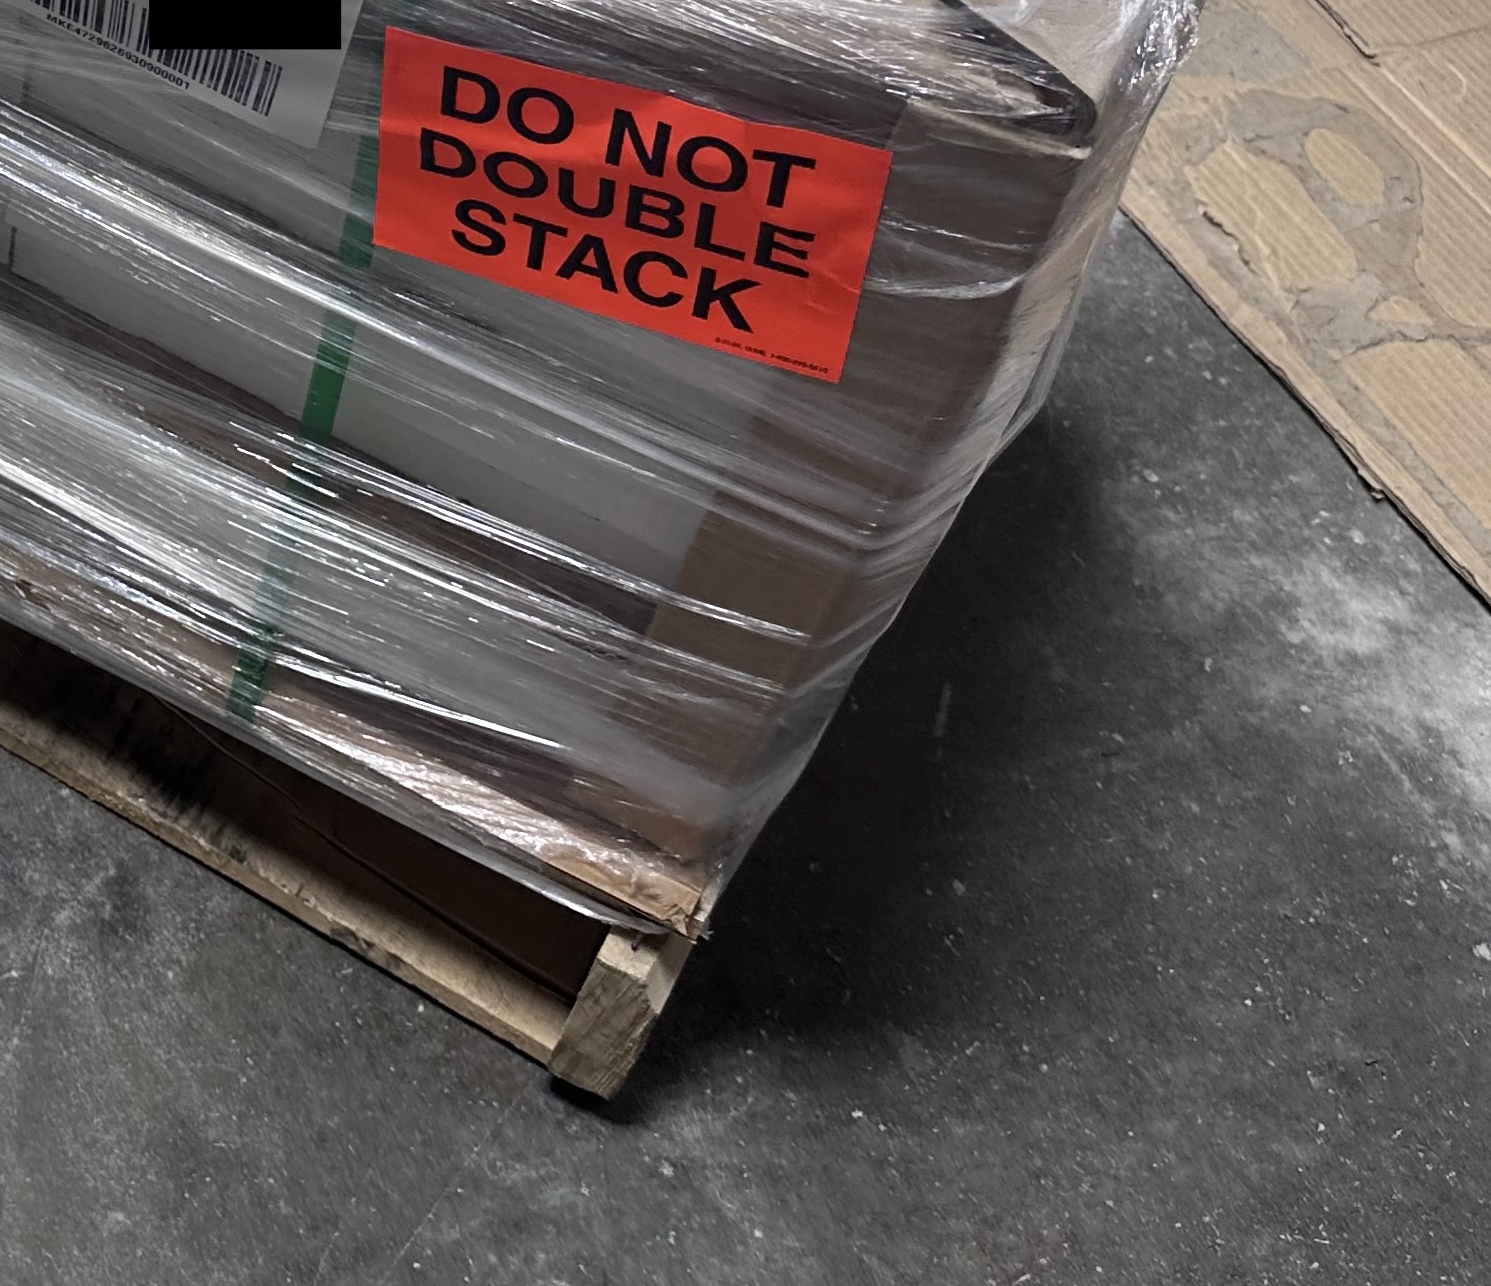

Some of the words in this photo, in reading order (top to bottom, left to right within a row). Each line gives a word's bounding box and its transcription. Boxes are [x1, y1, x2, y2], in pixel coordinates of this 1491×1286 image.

[419, 127, 816, 279] DOUBLE
[440, 65, 574, 145] DO
[605, 107, 817, 209] NOT
[451, 198, 764, 335] STACK
